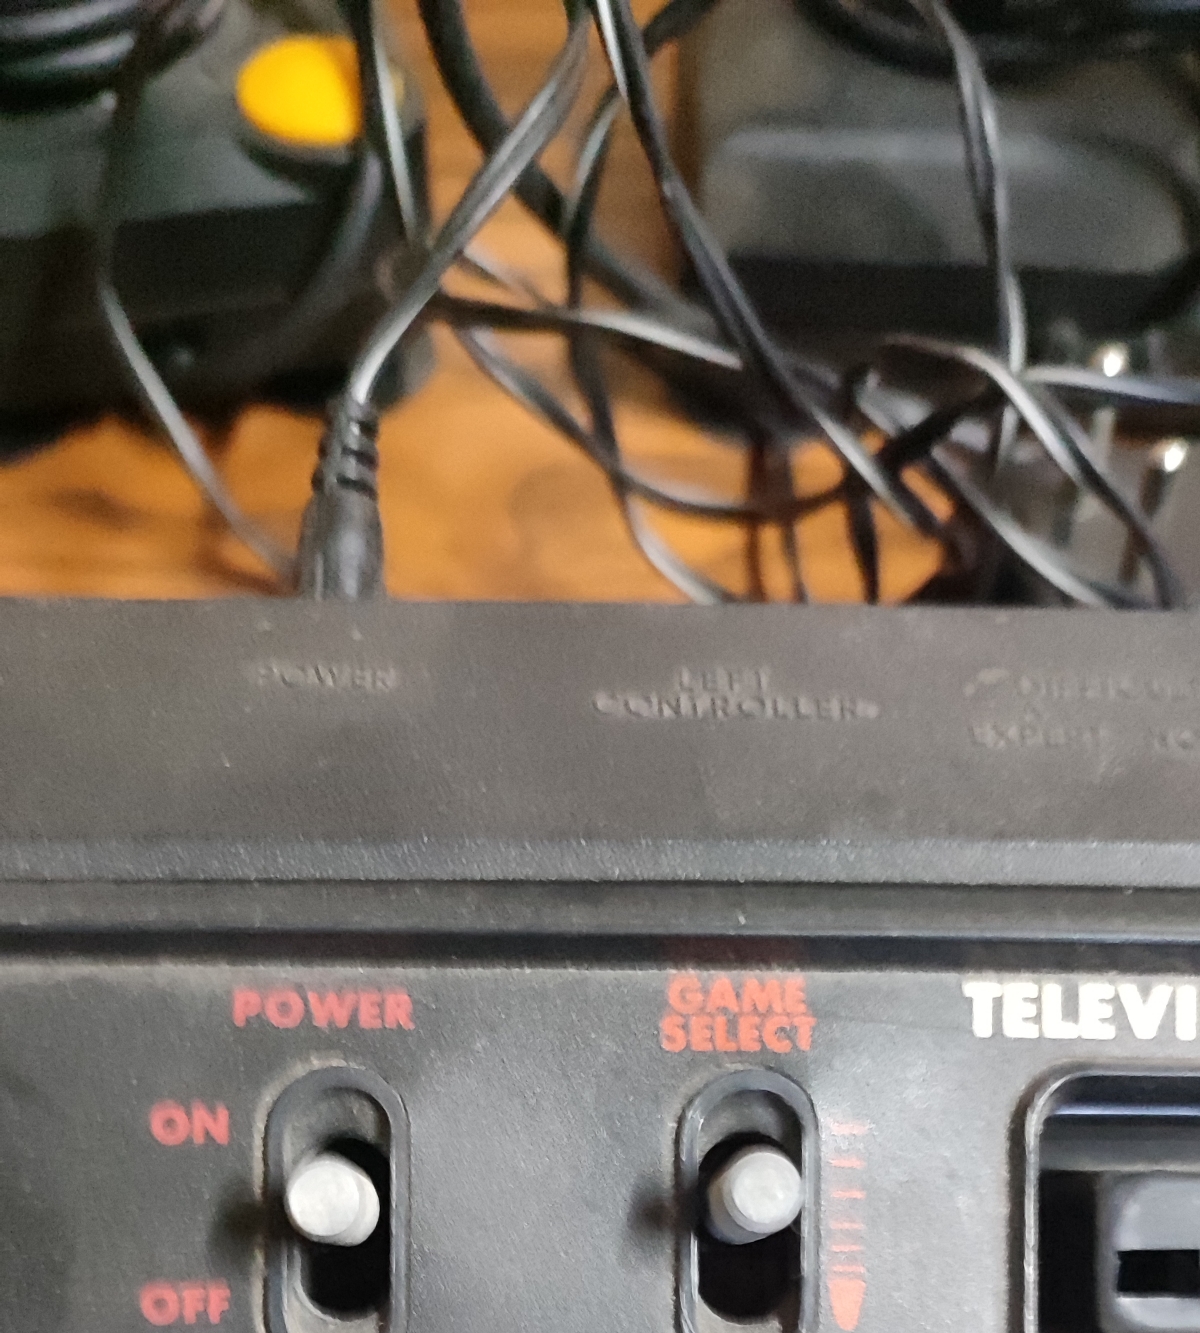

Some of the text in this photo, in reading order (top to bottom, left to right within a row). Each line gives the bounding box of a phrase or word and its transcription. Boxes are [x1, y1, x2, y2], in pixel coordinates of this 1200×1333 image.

[253, 661, 398, 690] POWER
[592, 691, 872, 720] CONTROLLER
[232, 987, 415, 1030] POWER
[667, 973, 808, 1015] GAME
[962, 982, 1198, 1040] TELEVI
[660, 1014, 817, 1053] SELECT
[149, 1100, 230, 1147] ON
[139, 1278, 231, 1327] OFF
